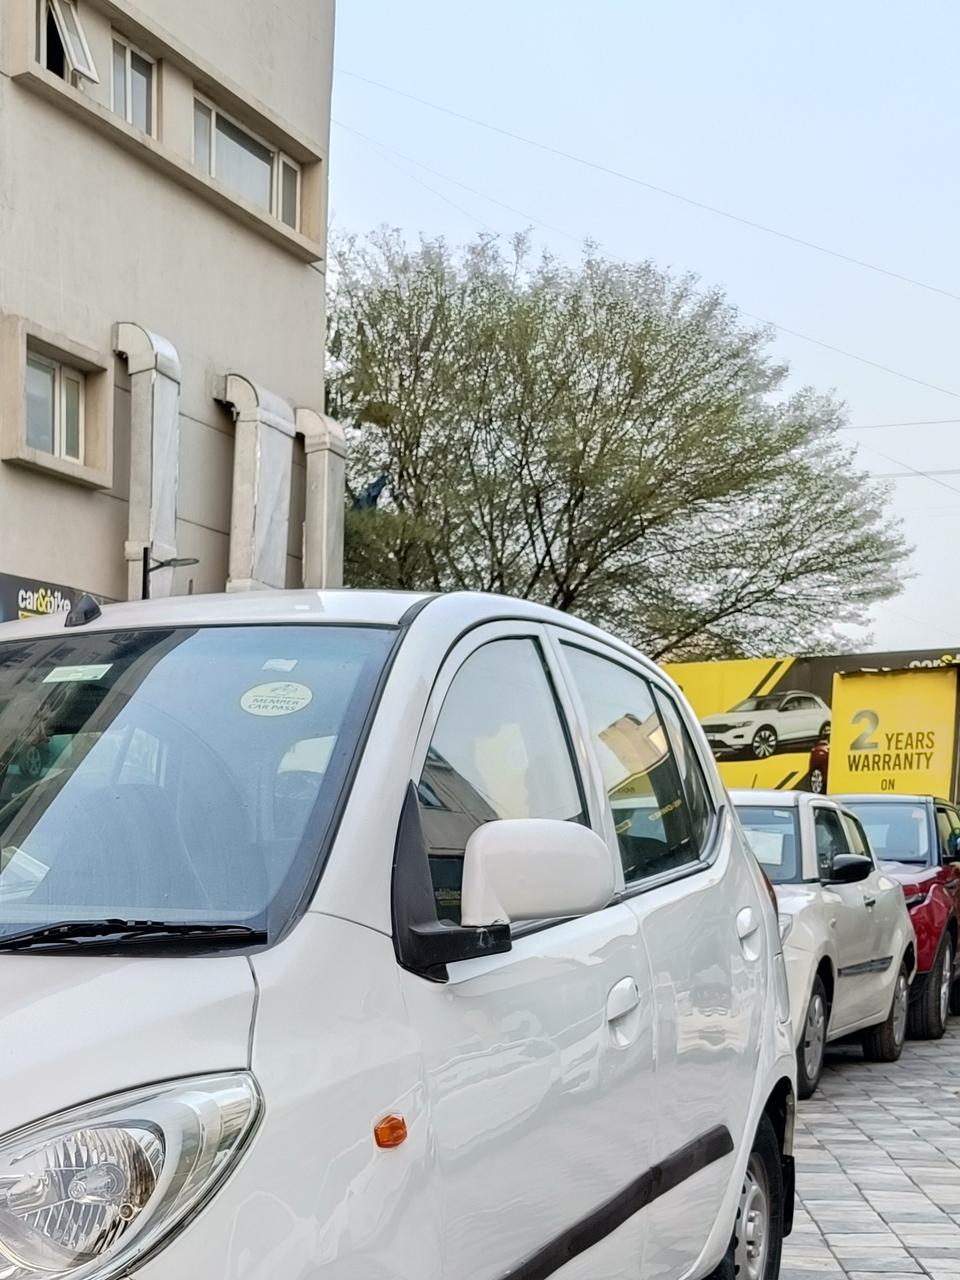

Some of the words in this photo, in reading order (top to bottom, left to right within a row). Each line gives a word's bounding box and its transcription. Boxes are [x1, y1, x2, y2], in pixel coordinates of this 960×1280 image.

[18, 588, 71, 614] car&bike
[849, 709, 880, 751] 2
[885, 731, 935, 751] YEARS
[847, 752, 933, 772] WARRANTY
[880, 778, 895, 791] ON
